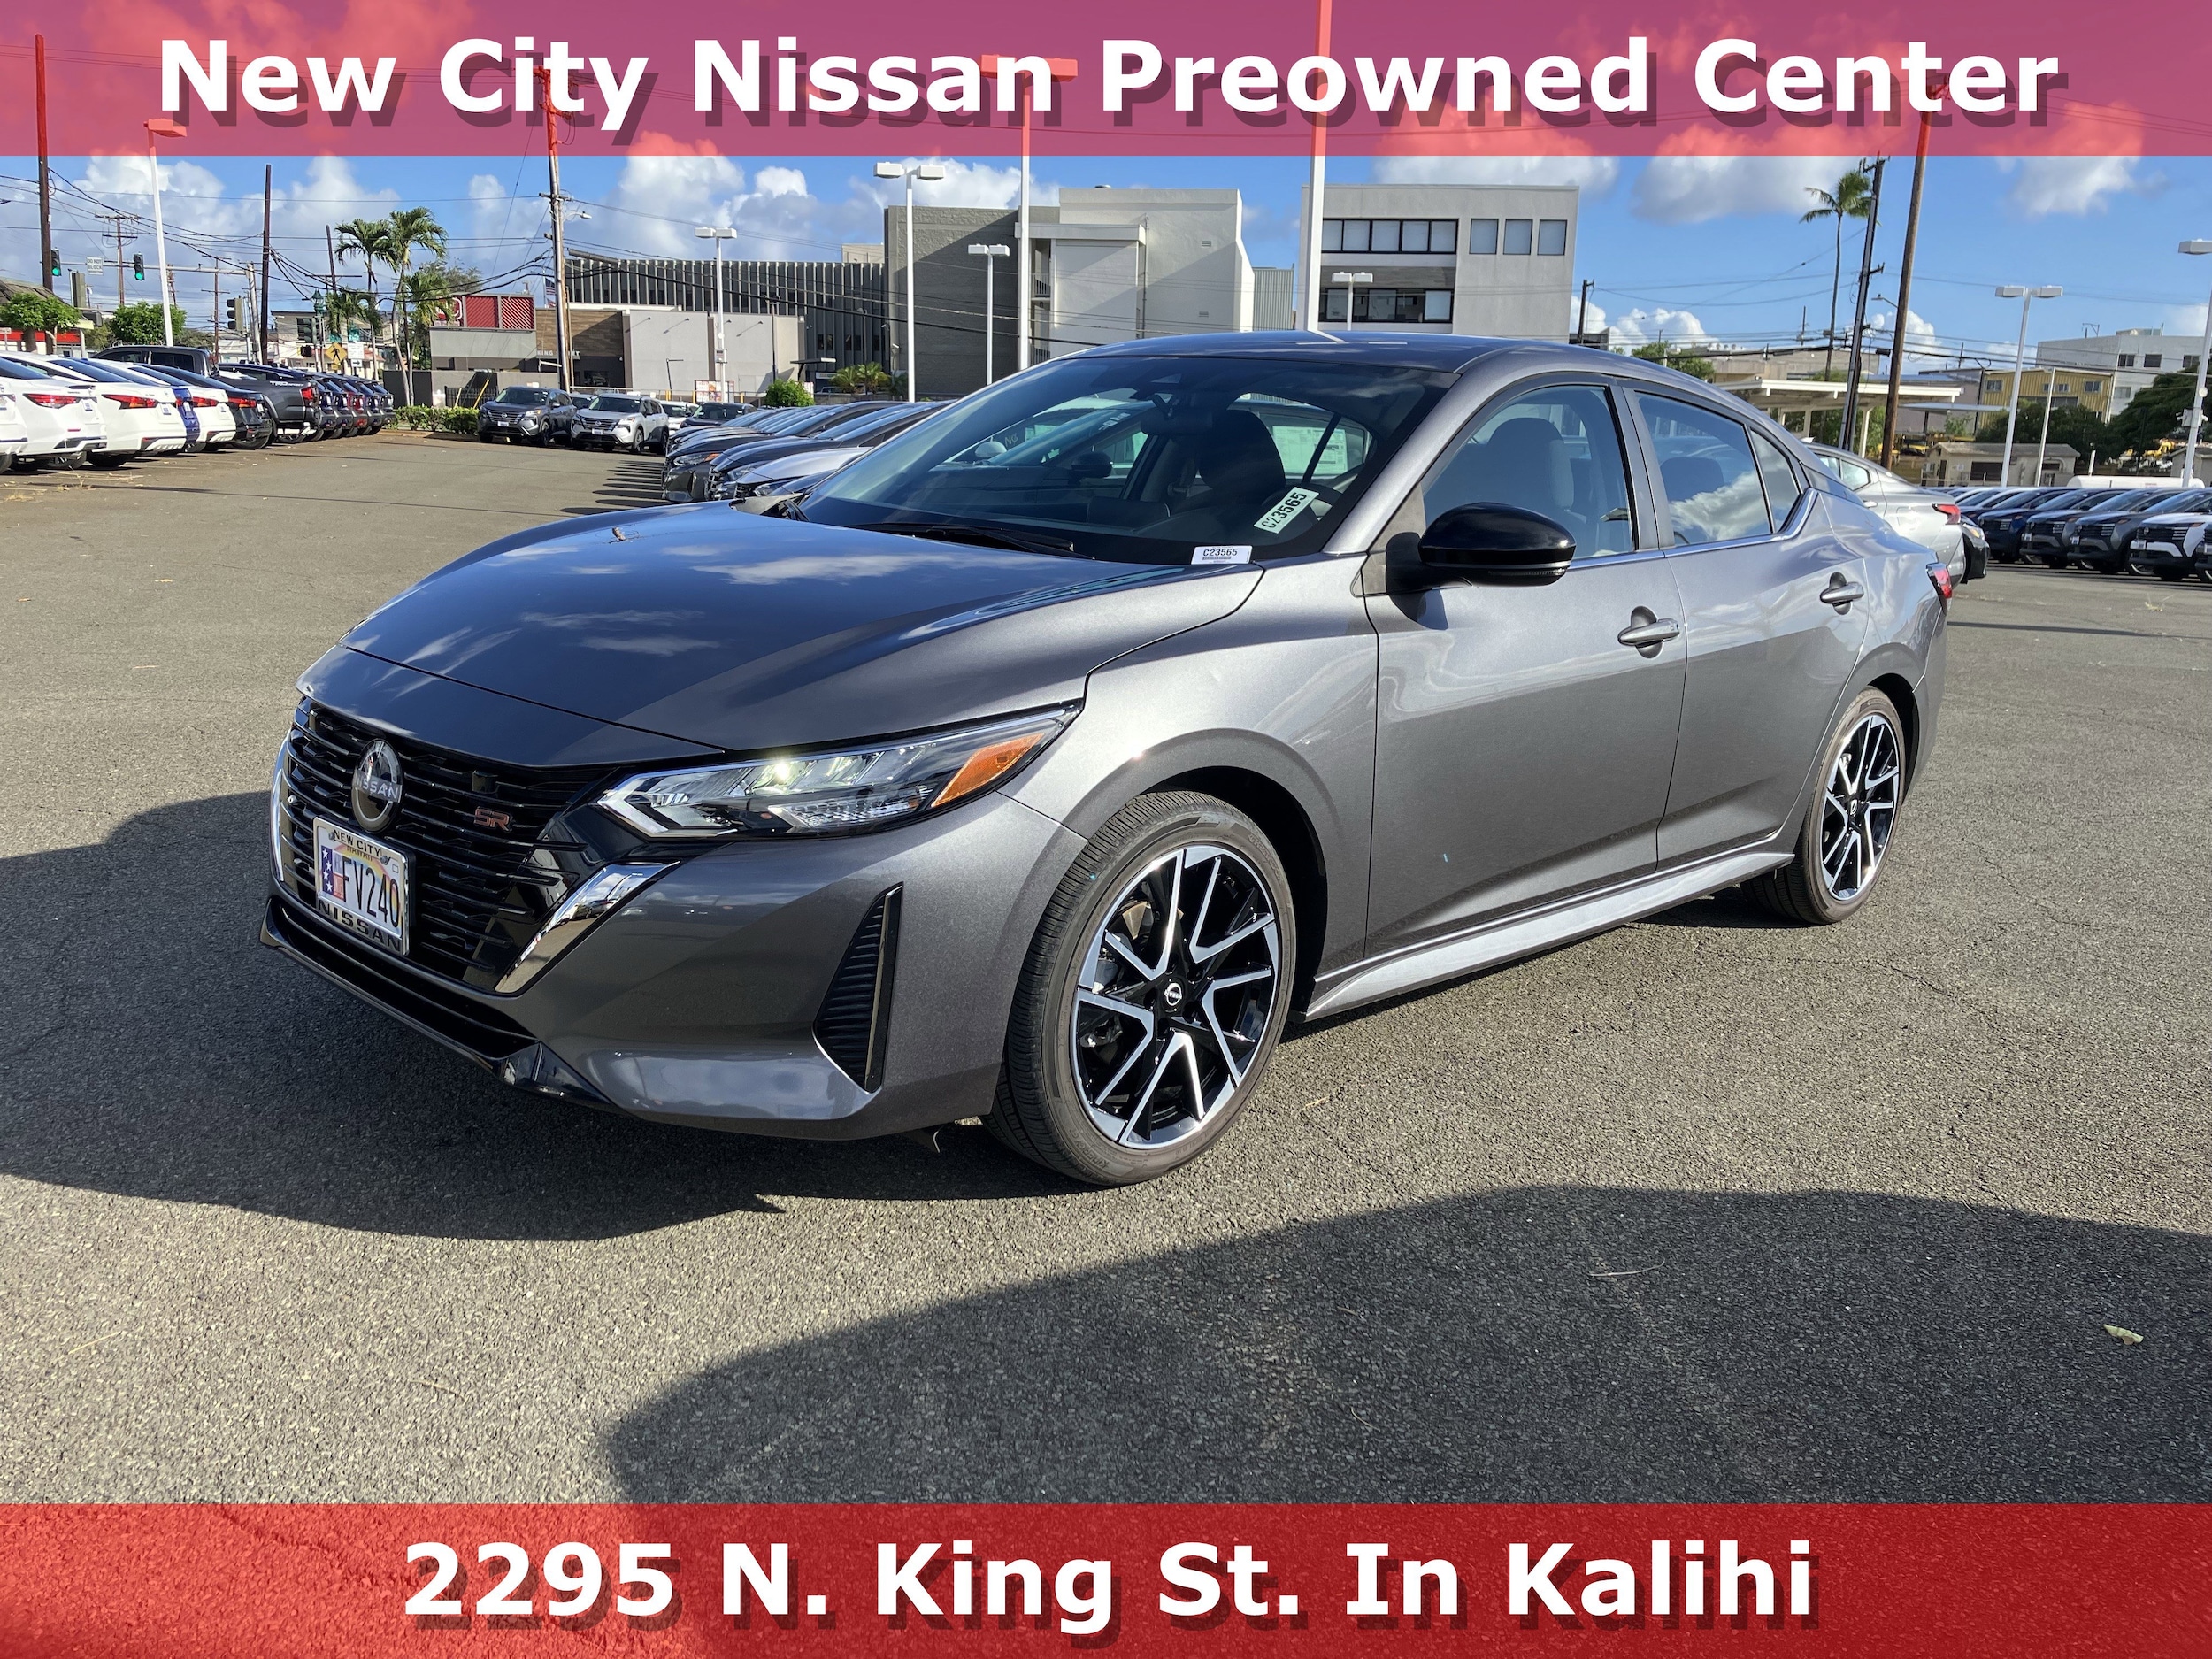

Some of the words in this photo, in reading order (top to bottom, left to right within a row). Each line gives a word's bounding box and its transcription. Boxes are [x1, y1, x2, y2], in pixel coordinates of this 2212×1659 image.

[1261, 492, 1307, 529] C23565
[473, 806, 510, 832] SR
[334, 829, 354, 846] NEW
[357, 840, 380, 857] CITY
[342, 855, 400, 928] FV240
[319, 899, 400, 953] NISSAN
